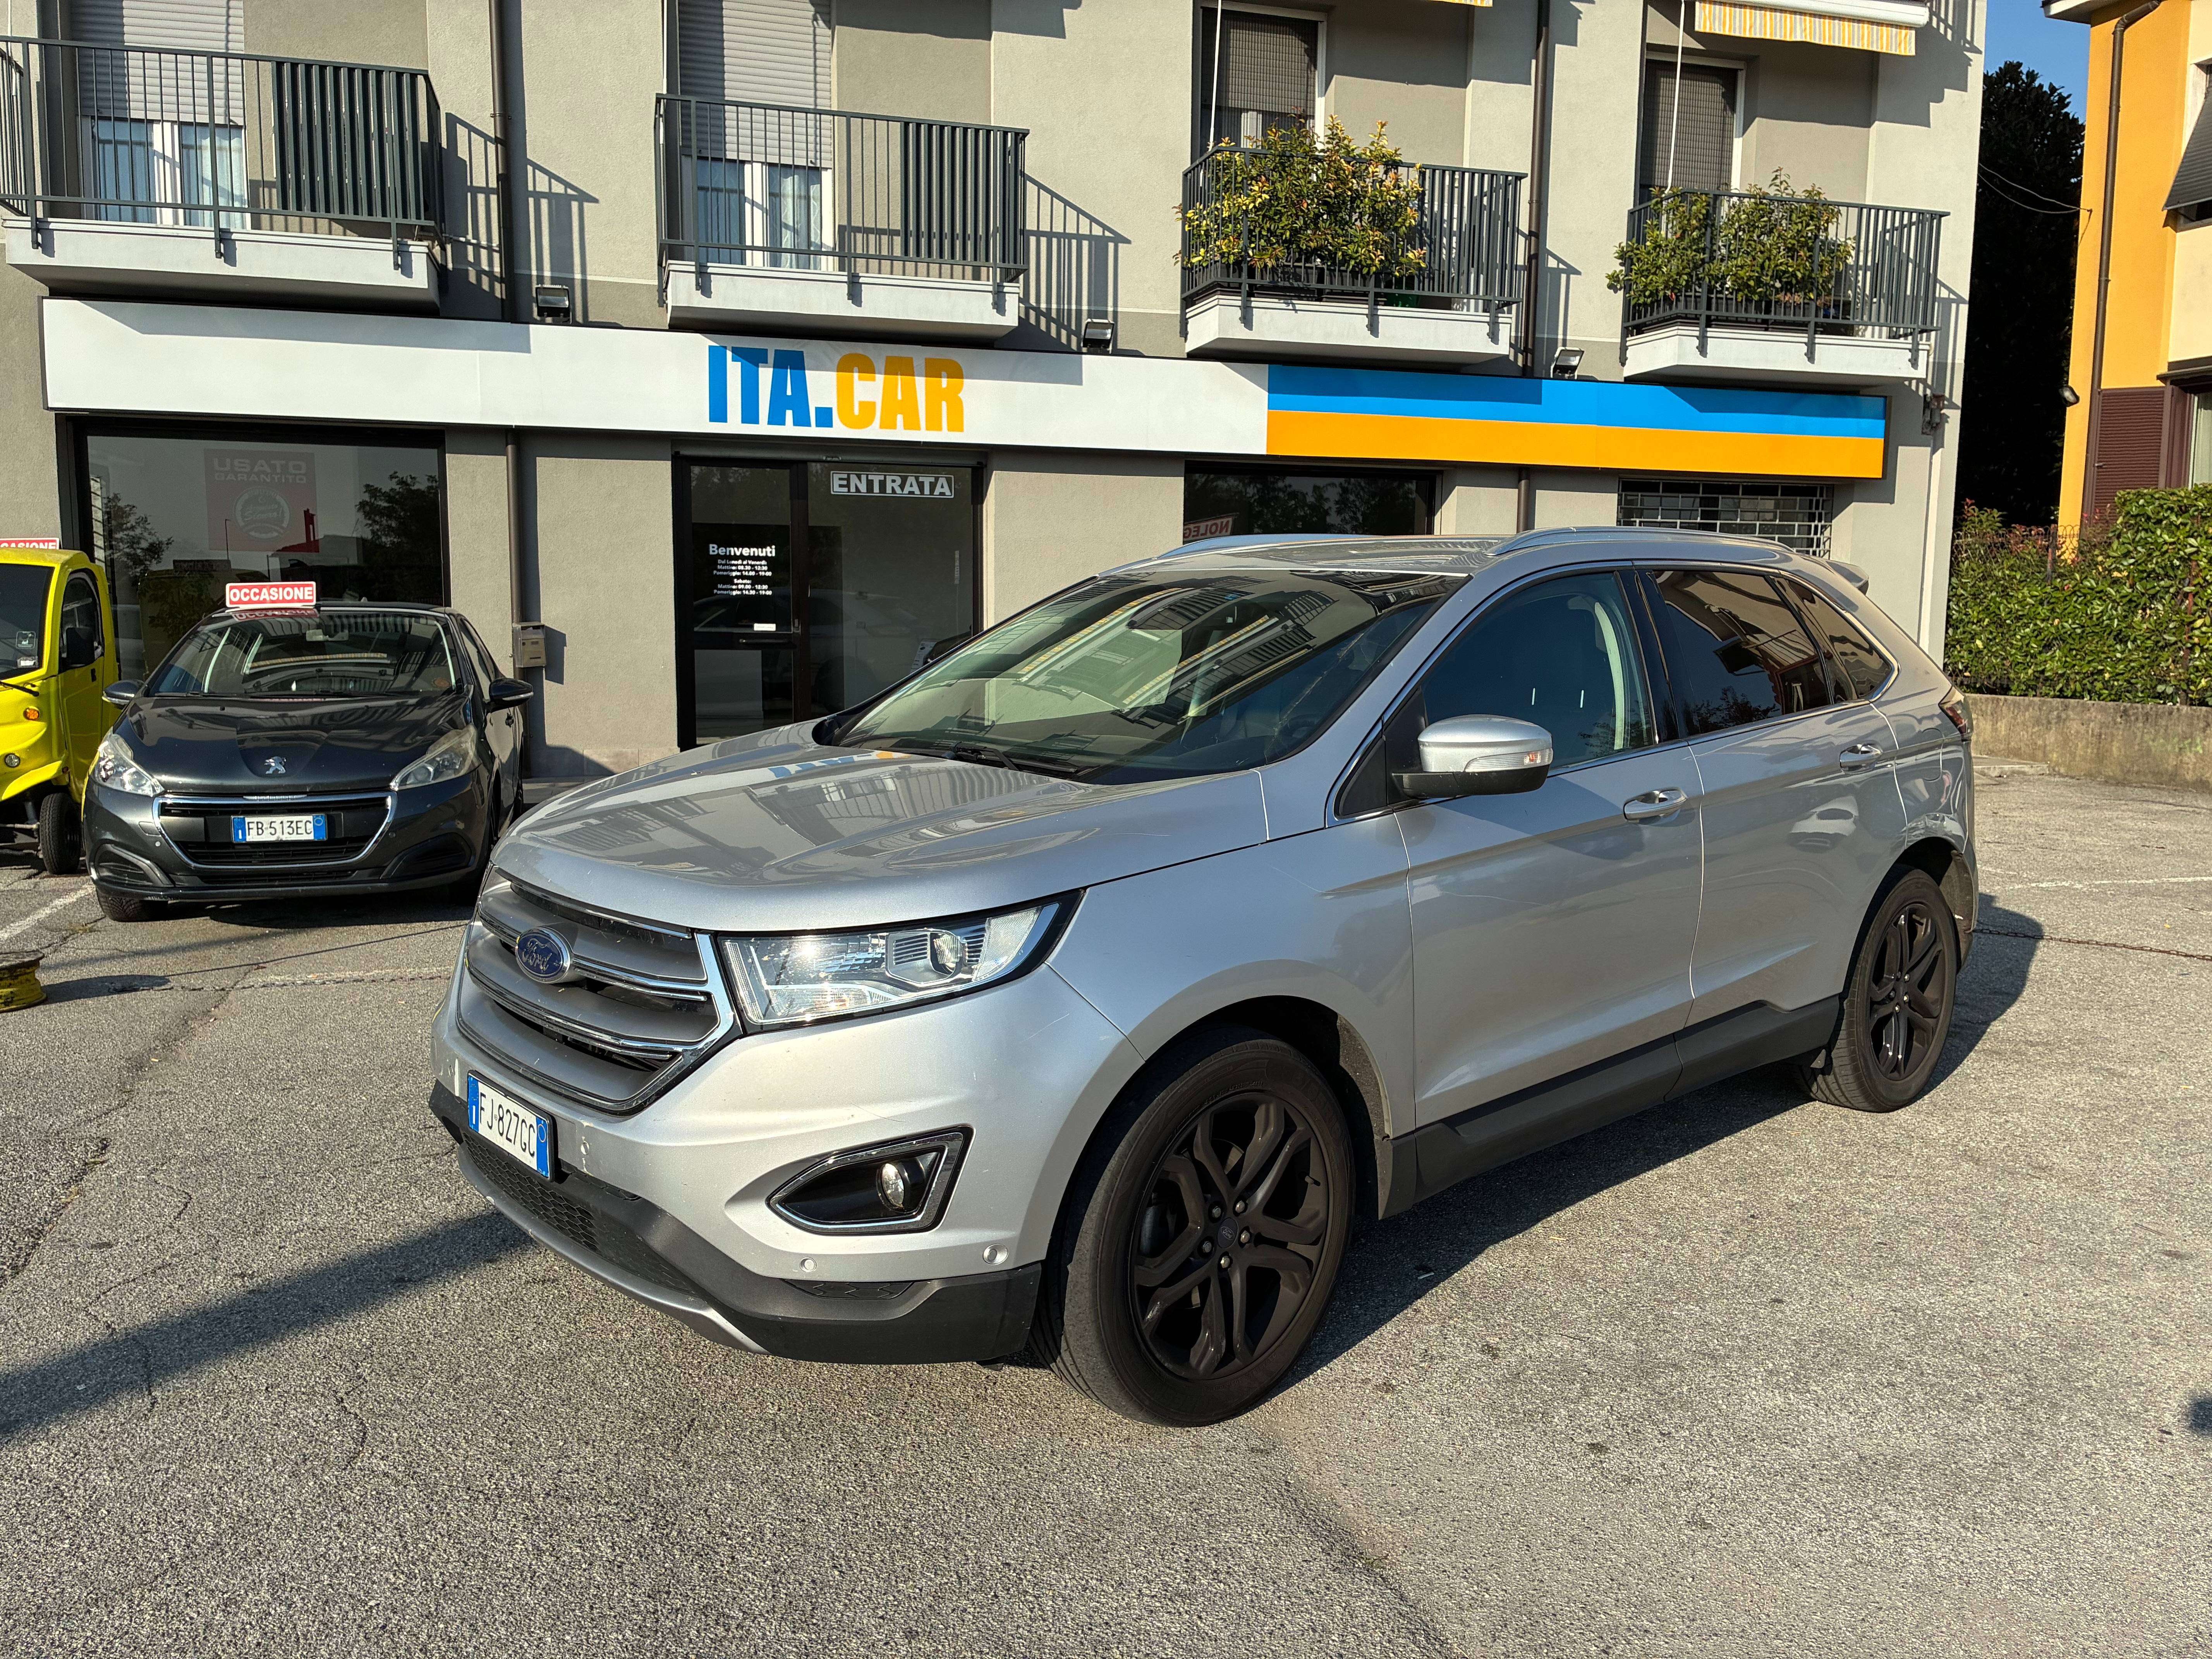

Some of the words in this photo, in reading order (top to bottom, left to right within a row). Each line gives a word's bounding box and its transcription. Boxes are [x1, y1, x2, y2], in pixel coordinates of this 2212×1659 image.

[708, 345, 964, 432] ITA.CAR
[213, 458, 307, 474] USATO
[215, 473, 306, 483] GARANTITO
[833, 473, 952, 496] ENTRATA
[709, 544, 775, 557] Benvenuti
[230, 587, 313, 601] OCCASIONE
